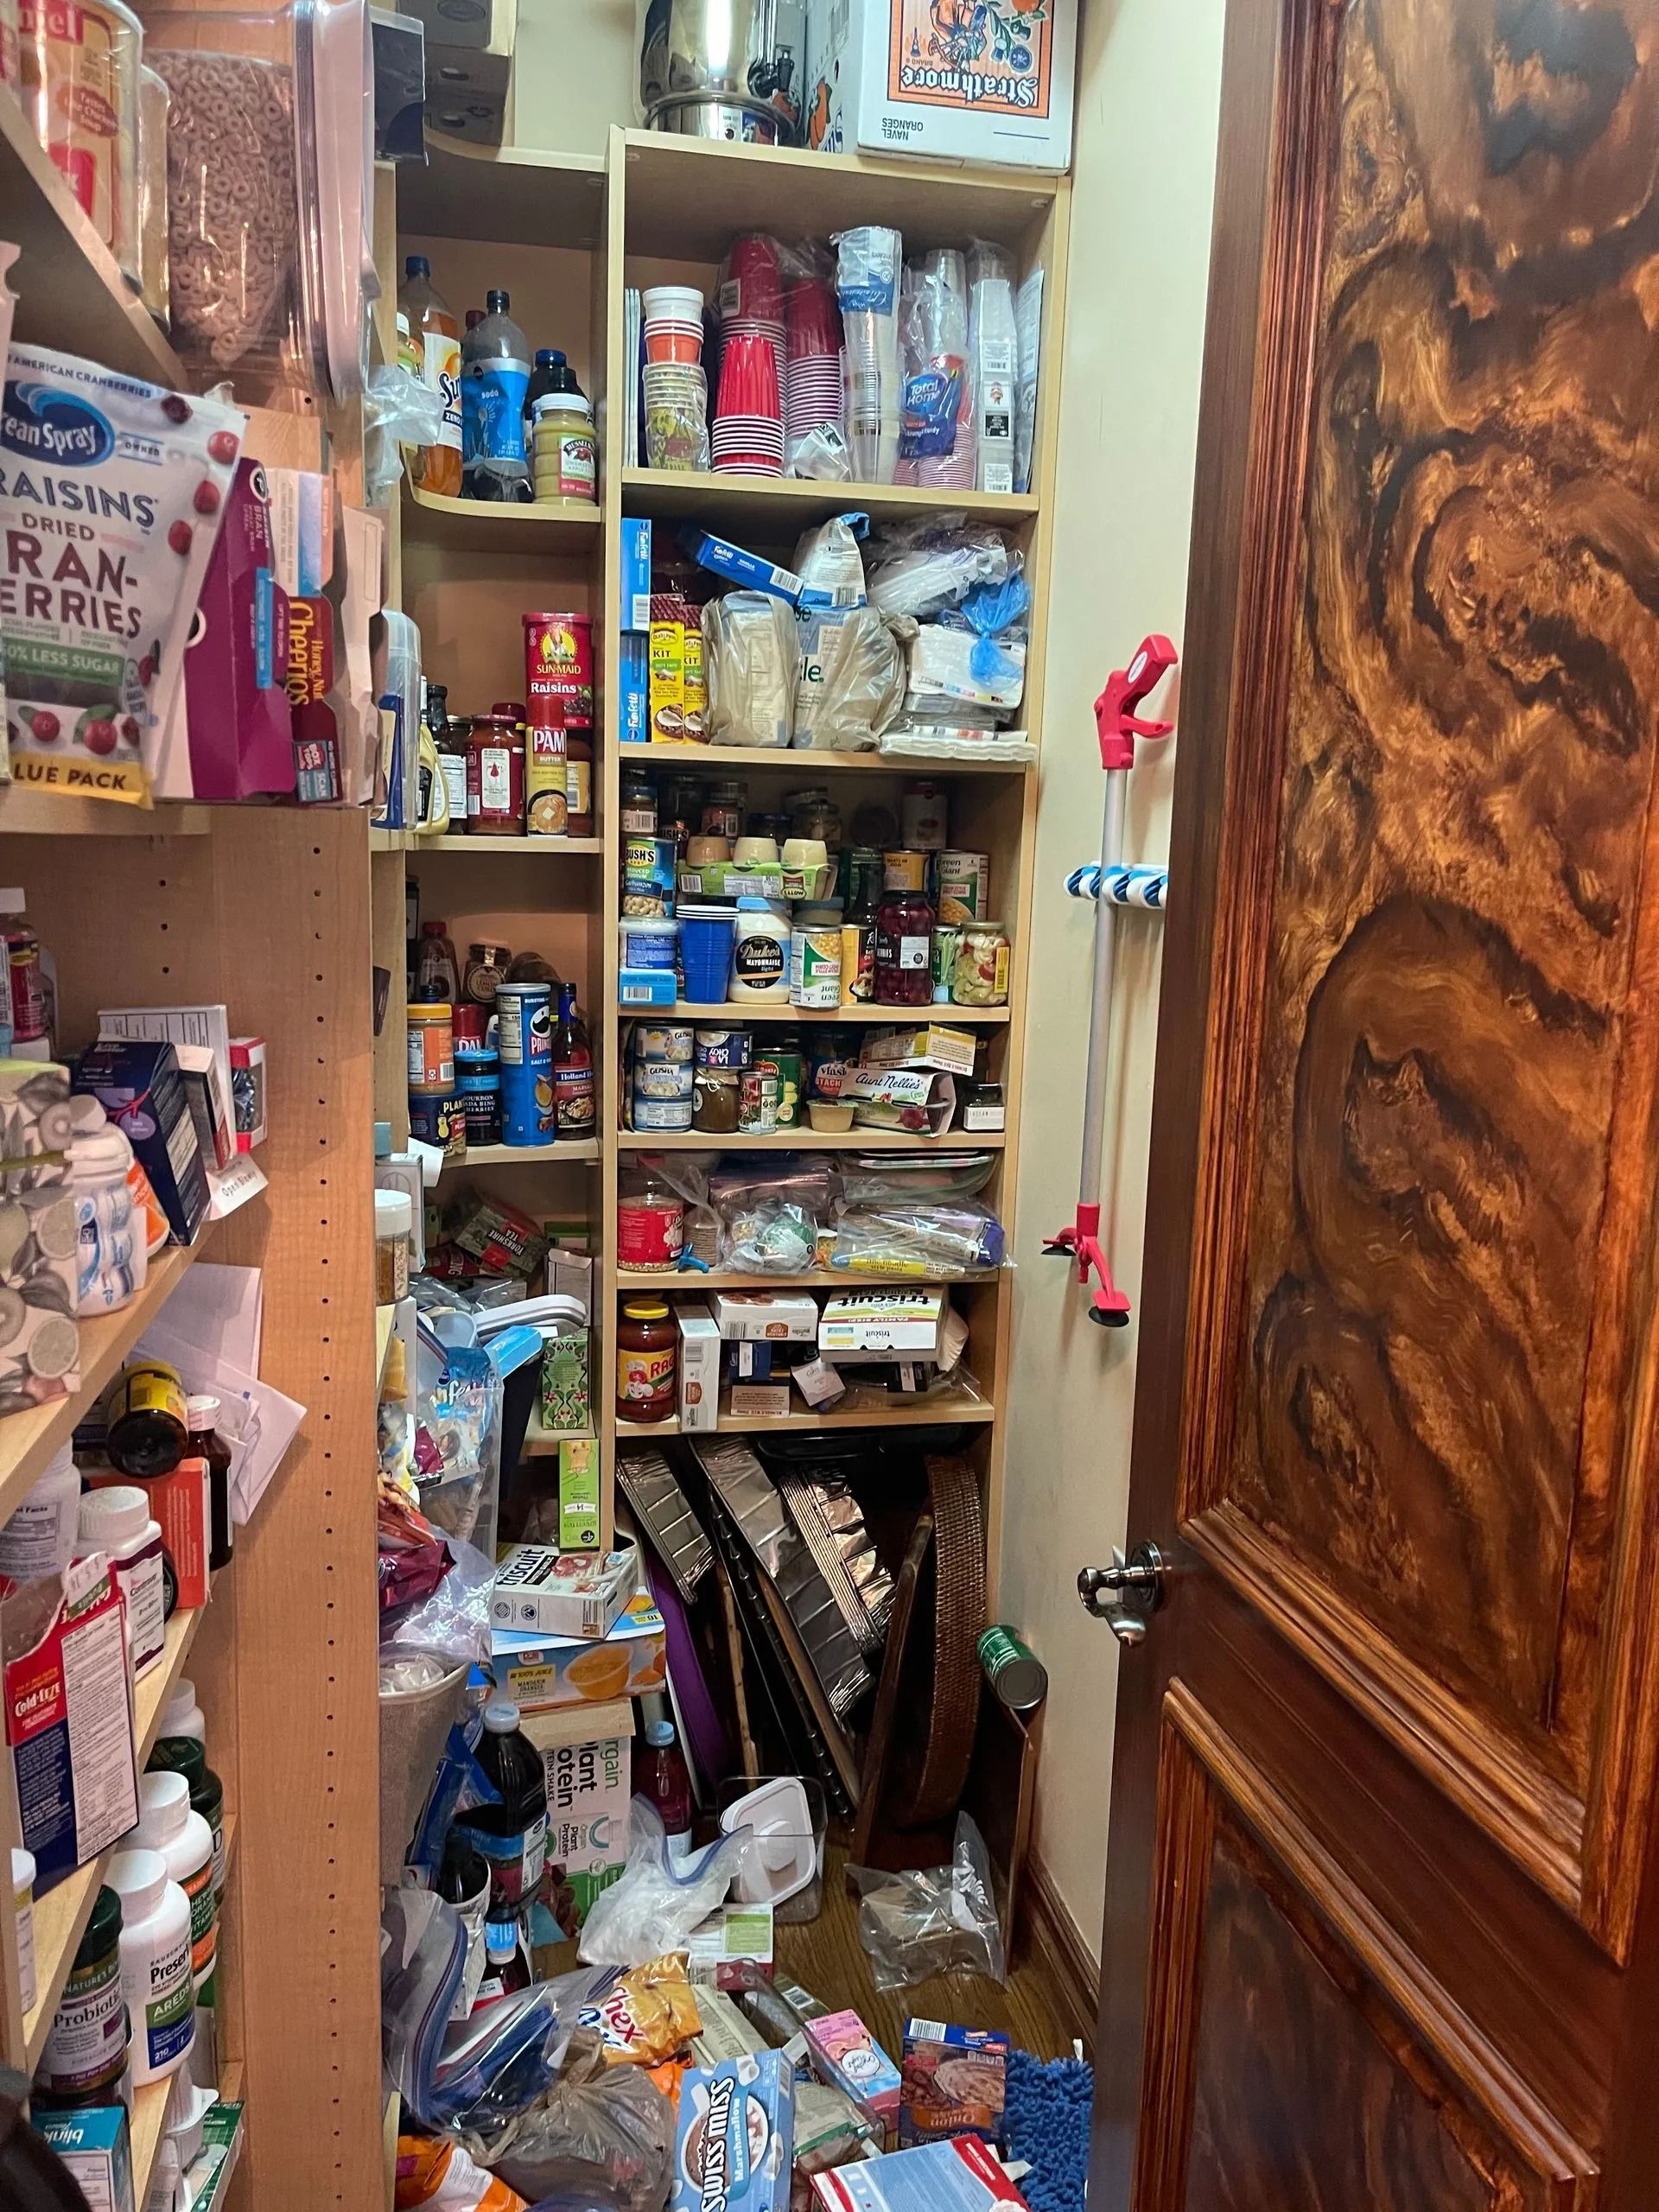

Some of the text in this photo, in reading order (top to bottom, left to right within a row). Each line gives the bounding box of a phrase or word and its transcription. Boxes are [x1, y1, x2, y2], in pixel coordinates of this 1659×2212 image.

[900, 66, 1038, 109] Strathmore
[881, 129, 909, 141] NAVEL
[882, 118, 924, 132] ORANGES
[13, 355, 152, 399] AMERICAN CRANBERRIES
[910, 378, 938, 397] Total
[481, 388, 499, 400] soda
[906, 388, 940, 405] Home
[445, 411, 461, 424] ZERO
[1, 413, 98, 457] ean Spray
[21, 512, 95, 542] DRIED
[253, 505, 264, 539] BRAN
[639, 531, 649, 563] Funfetti
[32, 648, 68, 667] LESS
[72, 654, 120, 673] SUGAR
[286, 601, 315, 705] Cheerios
[308, 639, 326, 700] Honey Nut
[798, 657, 824, 683] le.
[531, 683, 577, 694] Raisins
[627, 691, 639, 729] Funfetti
[533, 728, 565, 753] PAM
[303, 747, 315, 771] TOPS
[308, 743, 321, 766] BOX
[67, 768, 126, 791] PACK
[317, 772, 327, 797] SCAN
[626, 848, 655, 862] BUSH'S
[740, 943, 780, 960] Duke's
[746, 958, 781, 967] MAYONNAISE
[709, 1047, 729, 1058] CHOY
[717, 1055, 729, 1065] LA
[561, 1072, 586, 1081] Holland
[855, 1072, 921, 1090] Aunt Nellie's
[442, 1098, 464, 1113] PLAN
[220, 1182, 238, 1198] Open
[487, 1229, 524, 1256] YORKSHIRE
[505, 1229, 520, 1242] TEA
[837, 1294, 931, 1307] triscuit
[865, 1330, 890, 1338] triscuit
[496, 1549, 545, 1586] triscuit
[518, 1678, 546, 1688] MANDARIN
[534, 1668, 553, 1676] JUICE
[604, 1737, 620, 1789] rgain
[545, 1771, 556, 1802] SHAKE
[556, 1745, 575, 1808] otein
[560, 1823, 570, 1858] Protein
[569, 1826, 579, 1852] Plant
[63, 1970, 107, 1995] NATURE'S
[153, 1986, 190, 2018] AREDS
[154, 2050, 169, 2063] 210
[930, 2113, 976, 2127] Onion
[43, 2125, 84, 2145] blink
[701, 2075, 735, 2212] MISS SWISS
[731, 2098, 744, 2182] Marshmallow
